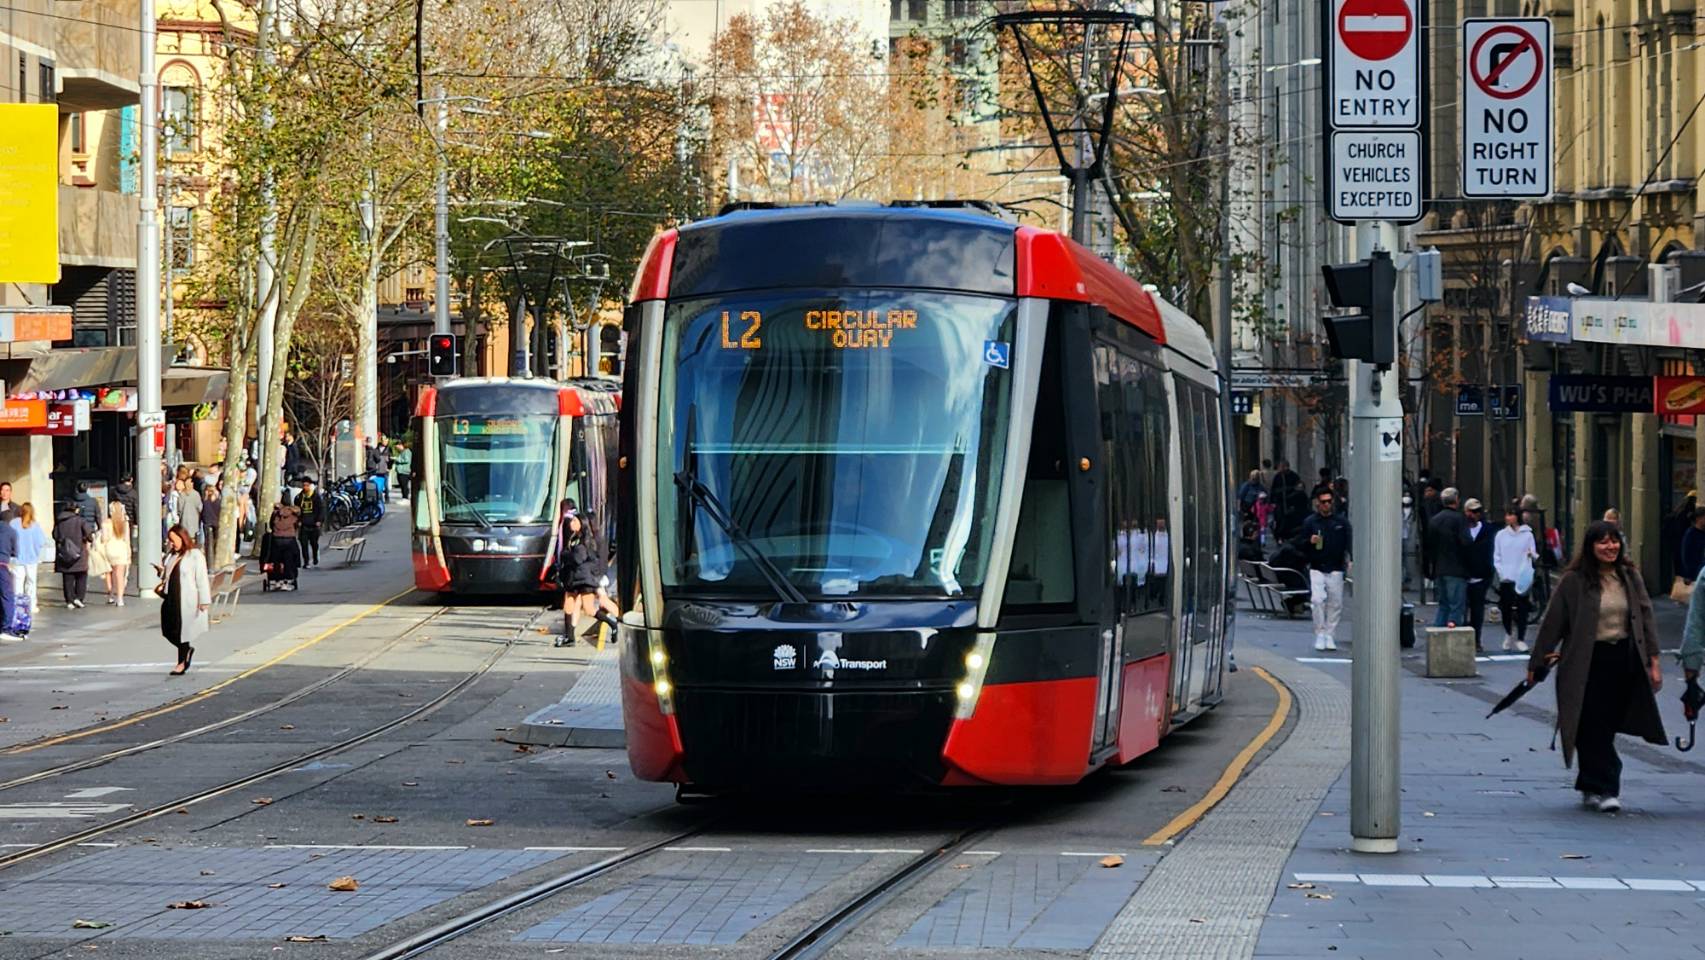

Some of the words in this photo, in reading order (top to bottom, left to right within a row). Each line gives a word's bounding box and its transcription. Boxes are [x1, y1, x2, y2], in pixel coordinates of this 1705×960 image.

[1355, 69, 1396, 91] NO
[1340, 98, 1411, 116] ENTRY
[1484, 108, 1528, 133] NO
[1348, 143, 1405, 159] CHURCH
[1473, 142, 1539, 160] RIGHT
[1343, 167, 1411, 183] VEHICLES
[1476, 168, 1536, 185] TURN
[1340, 191, 1412, 207] EXCEPTED
[806, 310, 918, 329] CIRCULAR
[721, 311, 762, 349] L2
[833, 329, 893, 348] QUAY
[1559, 383, 1608, 404] WU'S
[453, 417, 469, 435] L3
[774, 658, 797, 668] NSW
[840, 658, 887, 671] Transport
